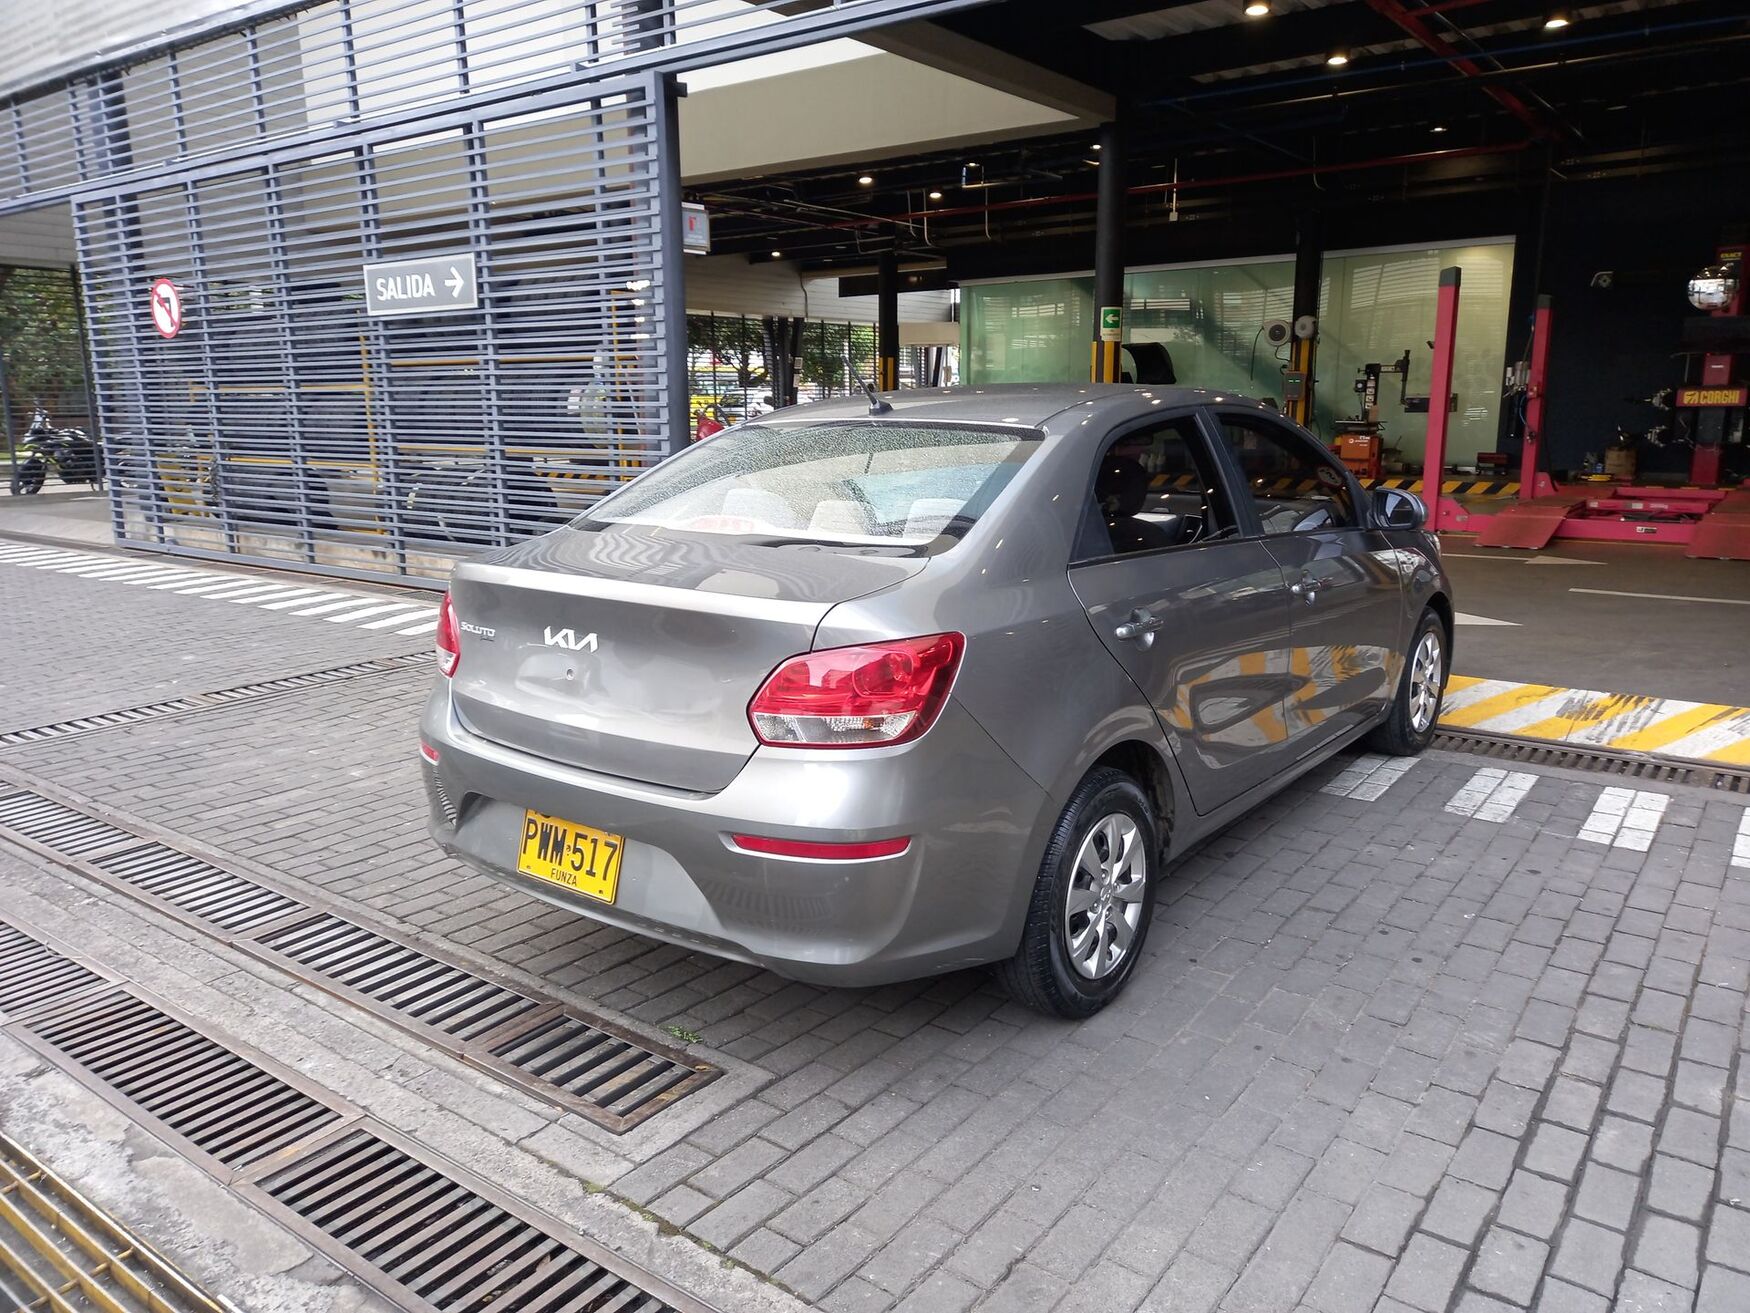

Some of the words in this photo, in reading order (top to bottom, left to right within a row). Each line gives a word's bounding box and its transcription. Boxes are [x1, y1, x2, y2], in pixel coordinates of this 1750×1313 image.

[376, 273, 436, 301] SALIDA
[1700, 390, 1740, 404] CORGHI
[460, 621, 496, 637] SOLUTO
[543, 625, 599, 653] KIA
[550, 867, 578, 887] FUNZA
